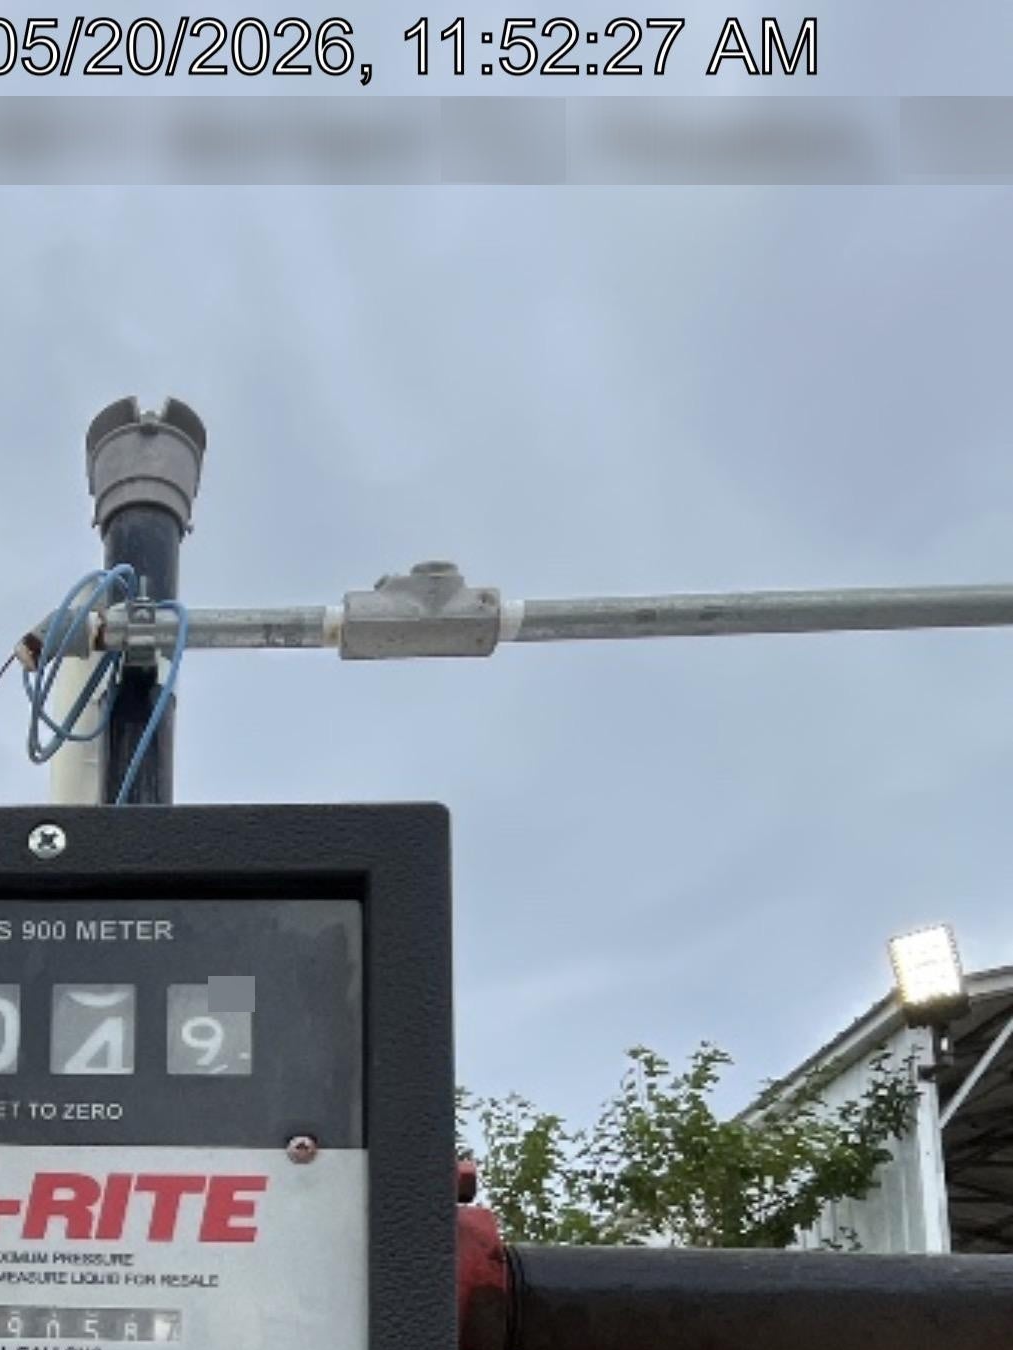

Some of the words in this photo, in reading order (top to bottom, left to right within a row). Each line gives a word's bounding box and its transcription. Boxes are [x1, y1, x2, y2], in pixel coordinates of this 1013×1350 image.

[22, 920, 67, 941] 900
[76, 920, 174, 941] METER
[29, 1102, 57, 1120] TO
[63, 1102, 124, 1121] ZERO
[52, 1253, 135, 1267] PRESSURE
[71, 1272, 119, 1285] LIQUID
[124, 1274, 156, 1286] FOR
[160, 1274, 219, 1288] RESALE
